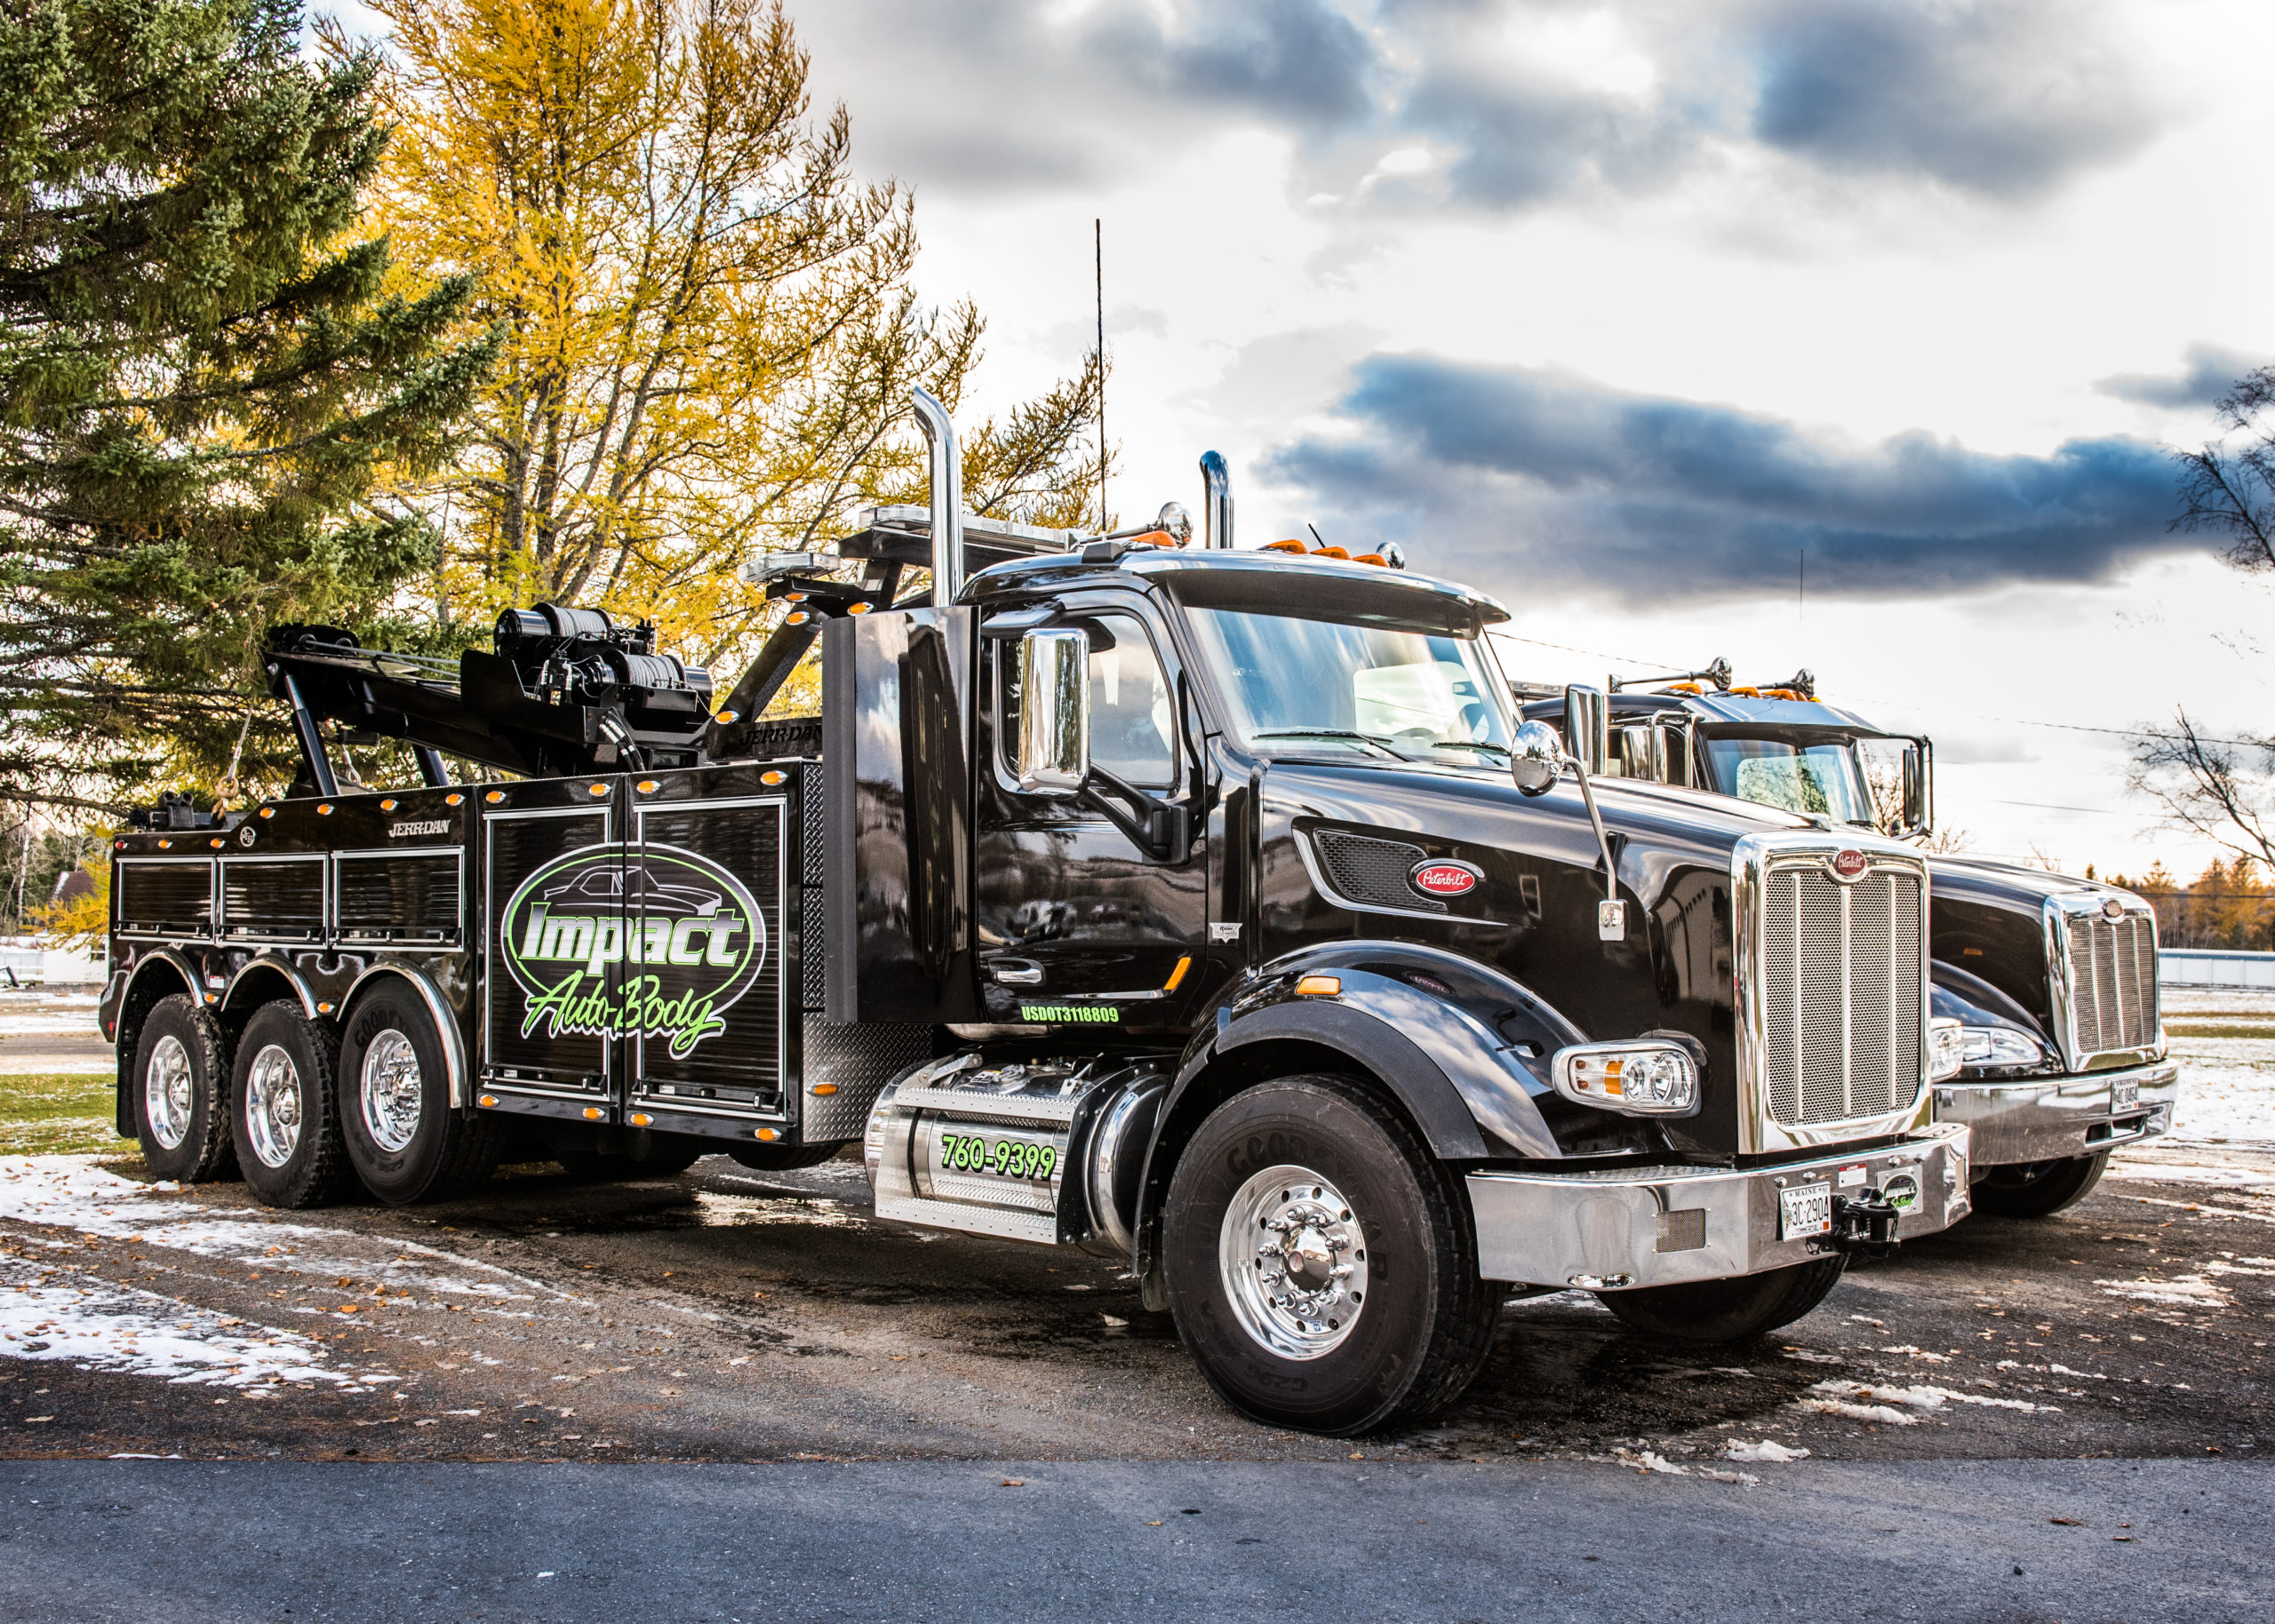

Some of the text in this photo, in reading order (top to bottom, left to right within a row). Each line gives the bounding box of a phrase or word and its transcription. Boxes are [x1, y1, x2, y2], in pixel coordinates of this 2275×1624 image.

[1839, 854, 1864, 869] Peterbilt
[1423, 870, 1470, 886] Peterbilt
[518, 902, 745, 977] Impact
[1020, 1006, 1120, 1023] USDOT3118809
[941, 1134, 1057, 1182] 760-9399
[1794, 1187, 1817, 1198] MAINE
